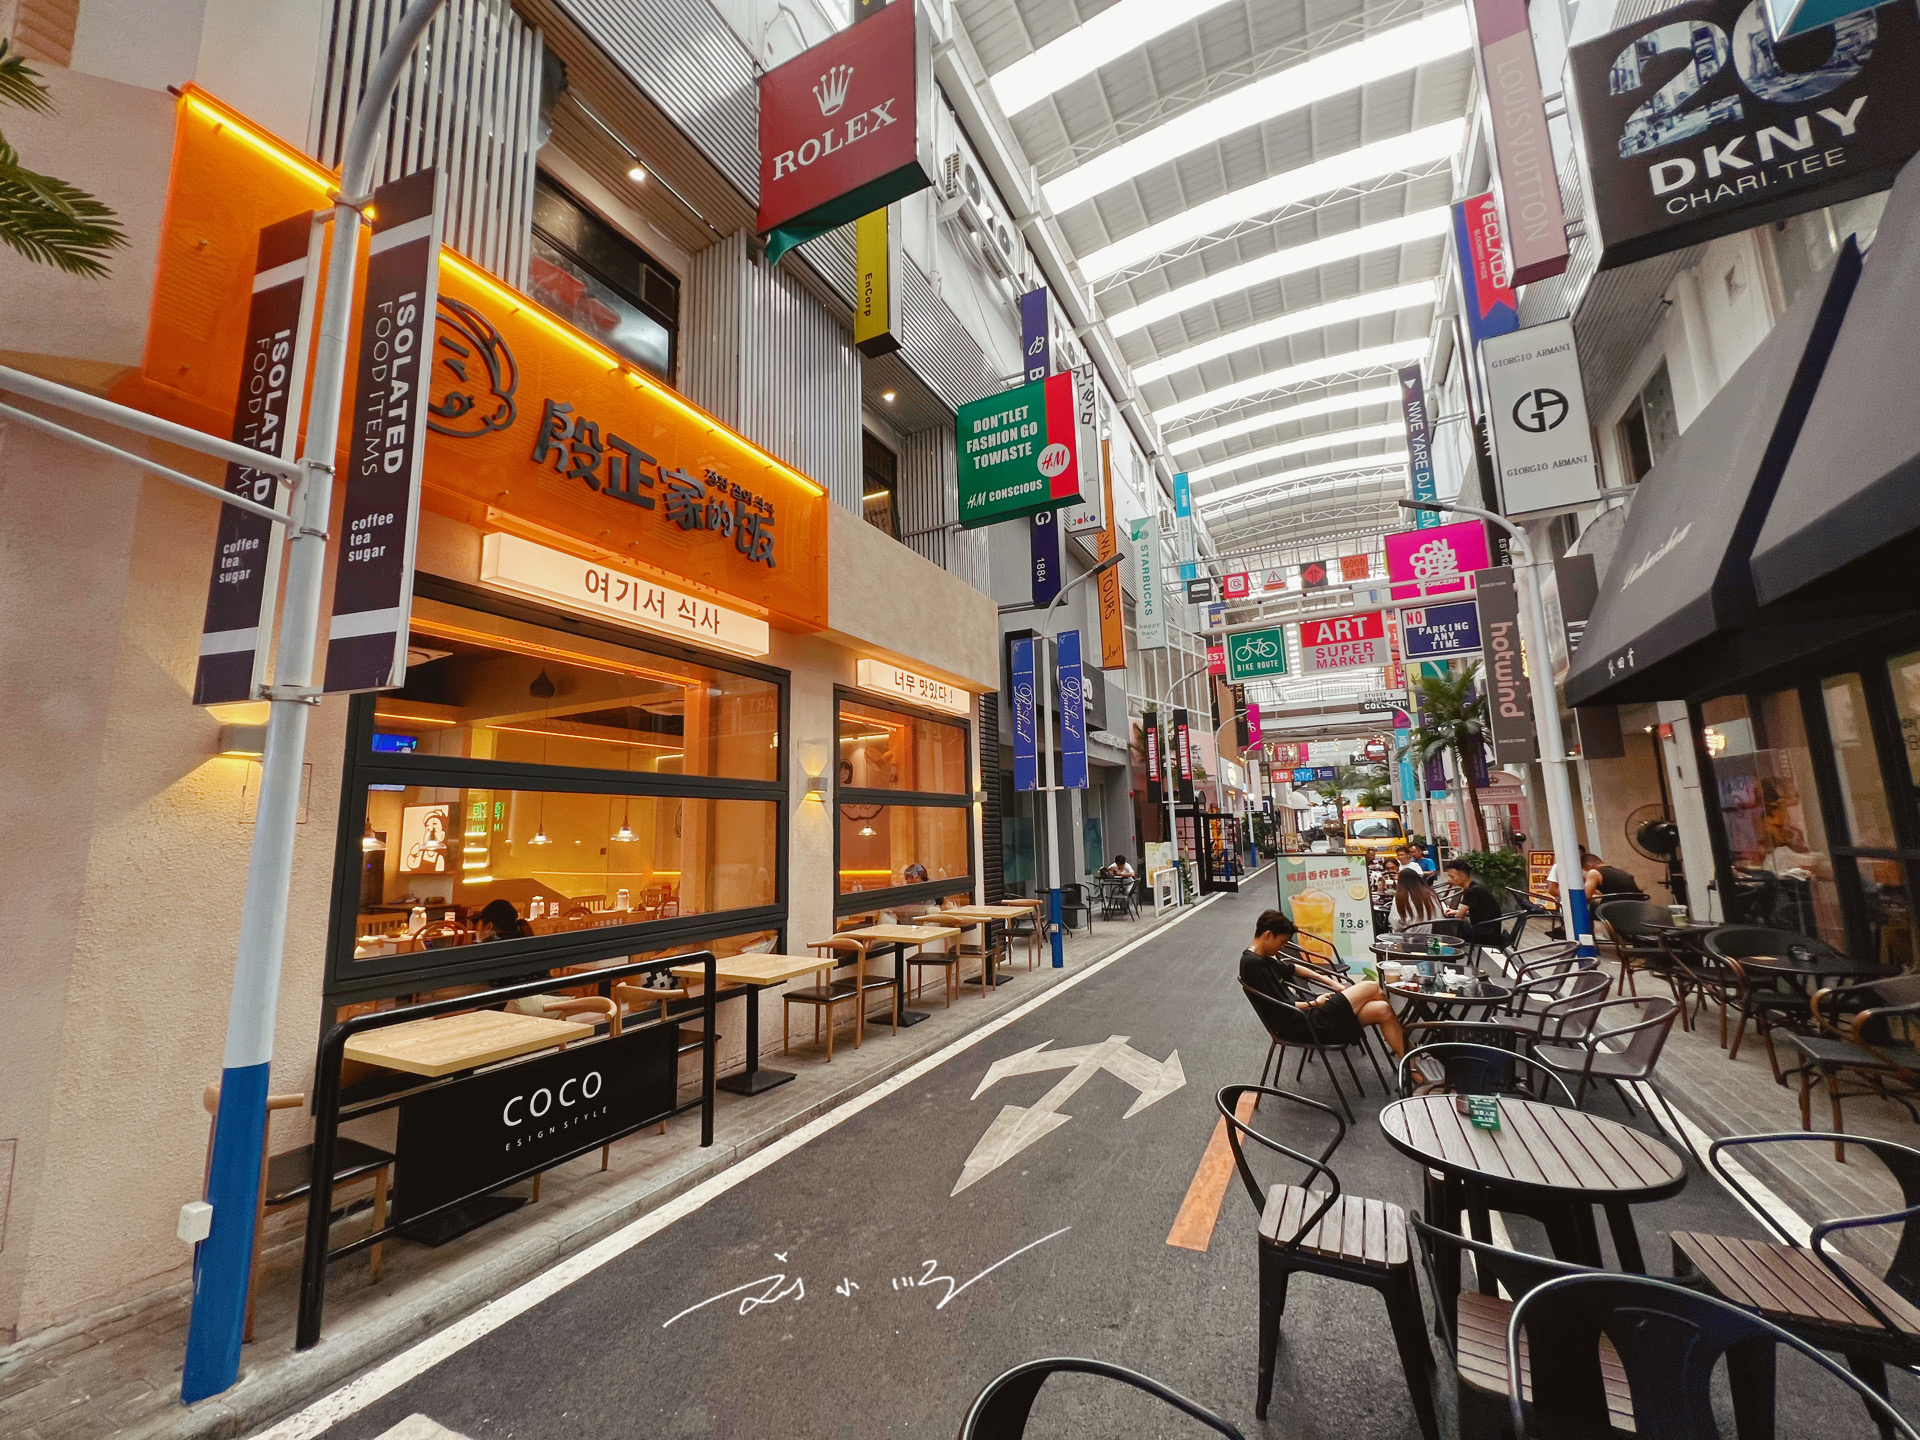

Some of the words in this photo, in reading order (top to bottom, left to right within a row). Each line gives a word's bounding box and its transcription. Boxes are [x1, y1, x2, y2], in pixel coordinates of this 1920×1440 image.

[772, 98, 897, 182] ROLEX
[1649, 95, 1869, 196] DKNY
[1482, 211, 1508, 289] ECLADO
[864, 272, 873, 317] EnCorp
[371, 301, 394, 384] FOOD
[1491, 352, 1533, 369] GIORGIO
[1535, 342, 1571, 360] ARMANI
[248, 338, 271, 415] FOOD
[383, 291, 417, 475] ISOLATED
[362, 391, 385, 477] ITEMS
[966, 427, 1018, 454] FASHION
[1020, 421, 1038, 438] GO
[1041, 449, 1066, 471] H&M
[1507, 461, 1549, 478] GIORGIO
[1552, 453, 1588, 470] ARMANI
[966, 491, 987, 509] H&M
[988, 479, 1043, 502] CONSCIOUS
[350, 512, 394, 532] coffee
[222, 537, 260, 555] coffee
[349, 531, 371, 547] tea
[221, 555, 240, 569] tea
[347, 545, 387, 564] sugar
[1343, 557, 1365, 569] GOOD
[218, 567, 251, 585] sugar
[1036, 557, 1046, 584] 1884
[1139, 543, 1153, 617] STARBUCKS
[585, 568, 667, 619] 여기서
[676, 598, 721, 634] 식사
[1102, 570, 1116, 621] TOURS
[1139, 622, 1160, 632] happy
[1316, 616, 1367, 644] ART
[1406, 611, 1422, 626] NO
[1418, 621, 1469, 635] PARKING
[1315, 641, 1374, 659] SUPER
[1430, 639, 1460, 650] TIME
[1433, 632, 1455, 642] ANY
[1236, 662, 1254, 672] BIKE
[1257, 659, 1279, 670] ROUTE
[1316, 653, 1375, 670] MARKET
[1490, 620, 1525, 718] hotwind
[894, 671, 916, 693] 너무
[503, 1071, 603, 1127] COCO
[505, 1126, 555, 1152] ESIGN
